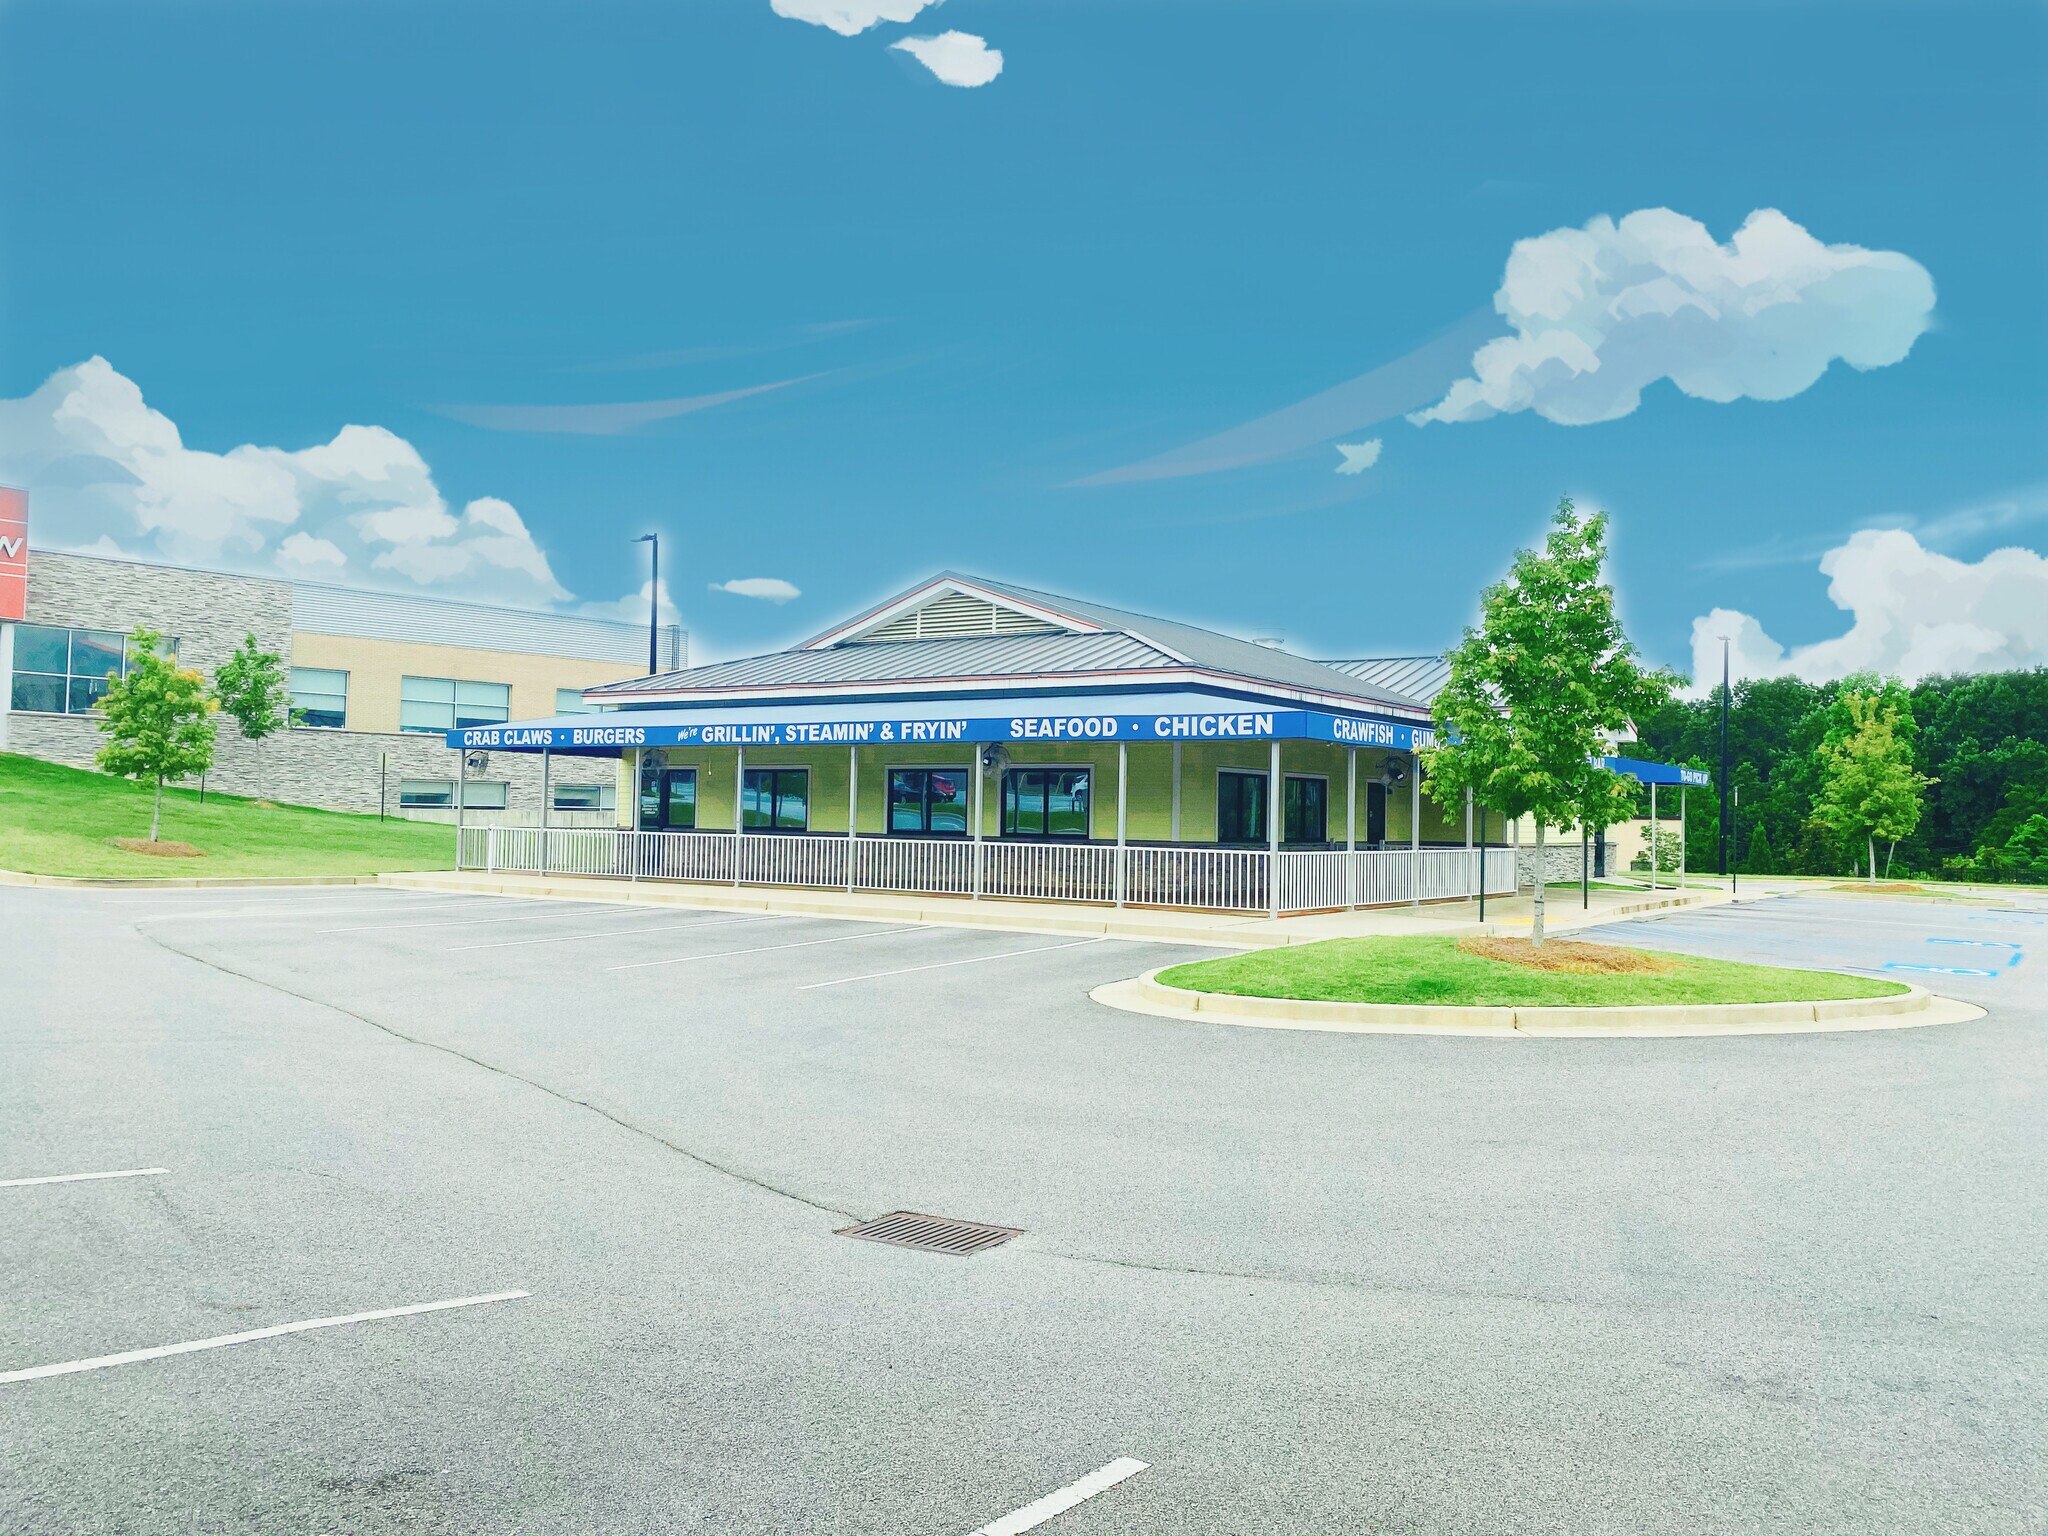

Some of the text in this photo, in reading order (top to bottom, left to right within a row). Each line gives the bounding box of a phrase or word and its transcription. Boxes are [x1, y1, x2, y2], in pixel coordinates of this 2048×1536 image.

[463, 728, 645, 745] CRAB CLAWS BURGERS
[677, 720, 968, 744] We're GRILLIN', STEAMIN' & FRYIN'
[1010, 714, 1273, 738] SEAFOOD CHICKEN
[1333, 718, 1394, 745] CRAWFISH
